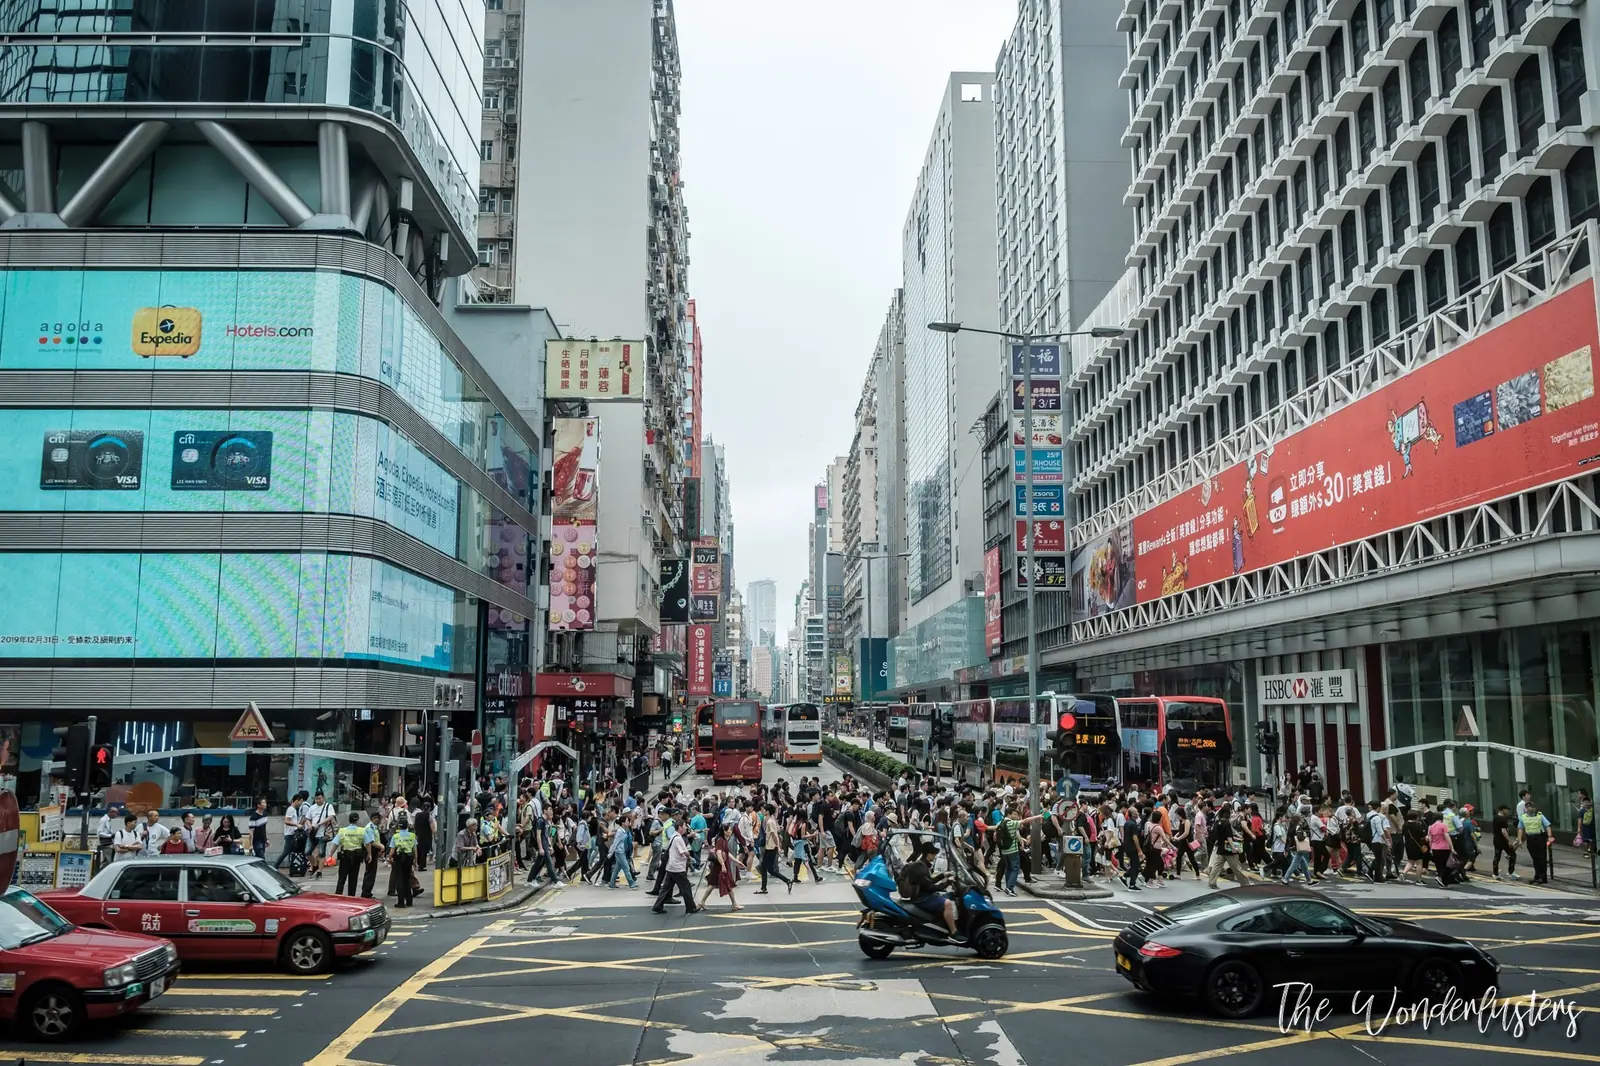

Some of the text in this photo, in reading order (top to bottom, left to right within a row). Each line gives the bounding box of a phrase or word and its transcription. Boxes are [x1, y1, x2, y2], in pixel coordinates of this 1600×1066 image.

[40, 320, 103, 334] agoda
[226, 324, 313, 338] Hotels.com
[141, 331, 193, 348] Expedia
[1038, 398, 1058, 409] 3/F
[48, 432, 66, 444] citi
[179, 432, 196, 445] citi
[1550, 429, 1574, 445] Together
[116, 475, 138, 484] VISA
[245, 475, 268, 485] VISA
[1290, 461, 1326, 492] 立即分享
[697, 555, 716, 563] 10/F
[1047, 575, 1065, 585] 5/F
[1264, 678, 1293, 700] HSBC
[575, 700, 598, 708] 周大福
[1094, 735, 1107, 745] 112
[141, 913, 162, 922] 的士
[141, 921, 161, 931] TAXI
